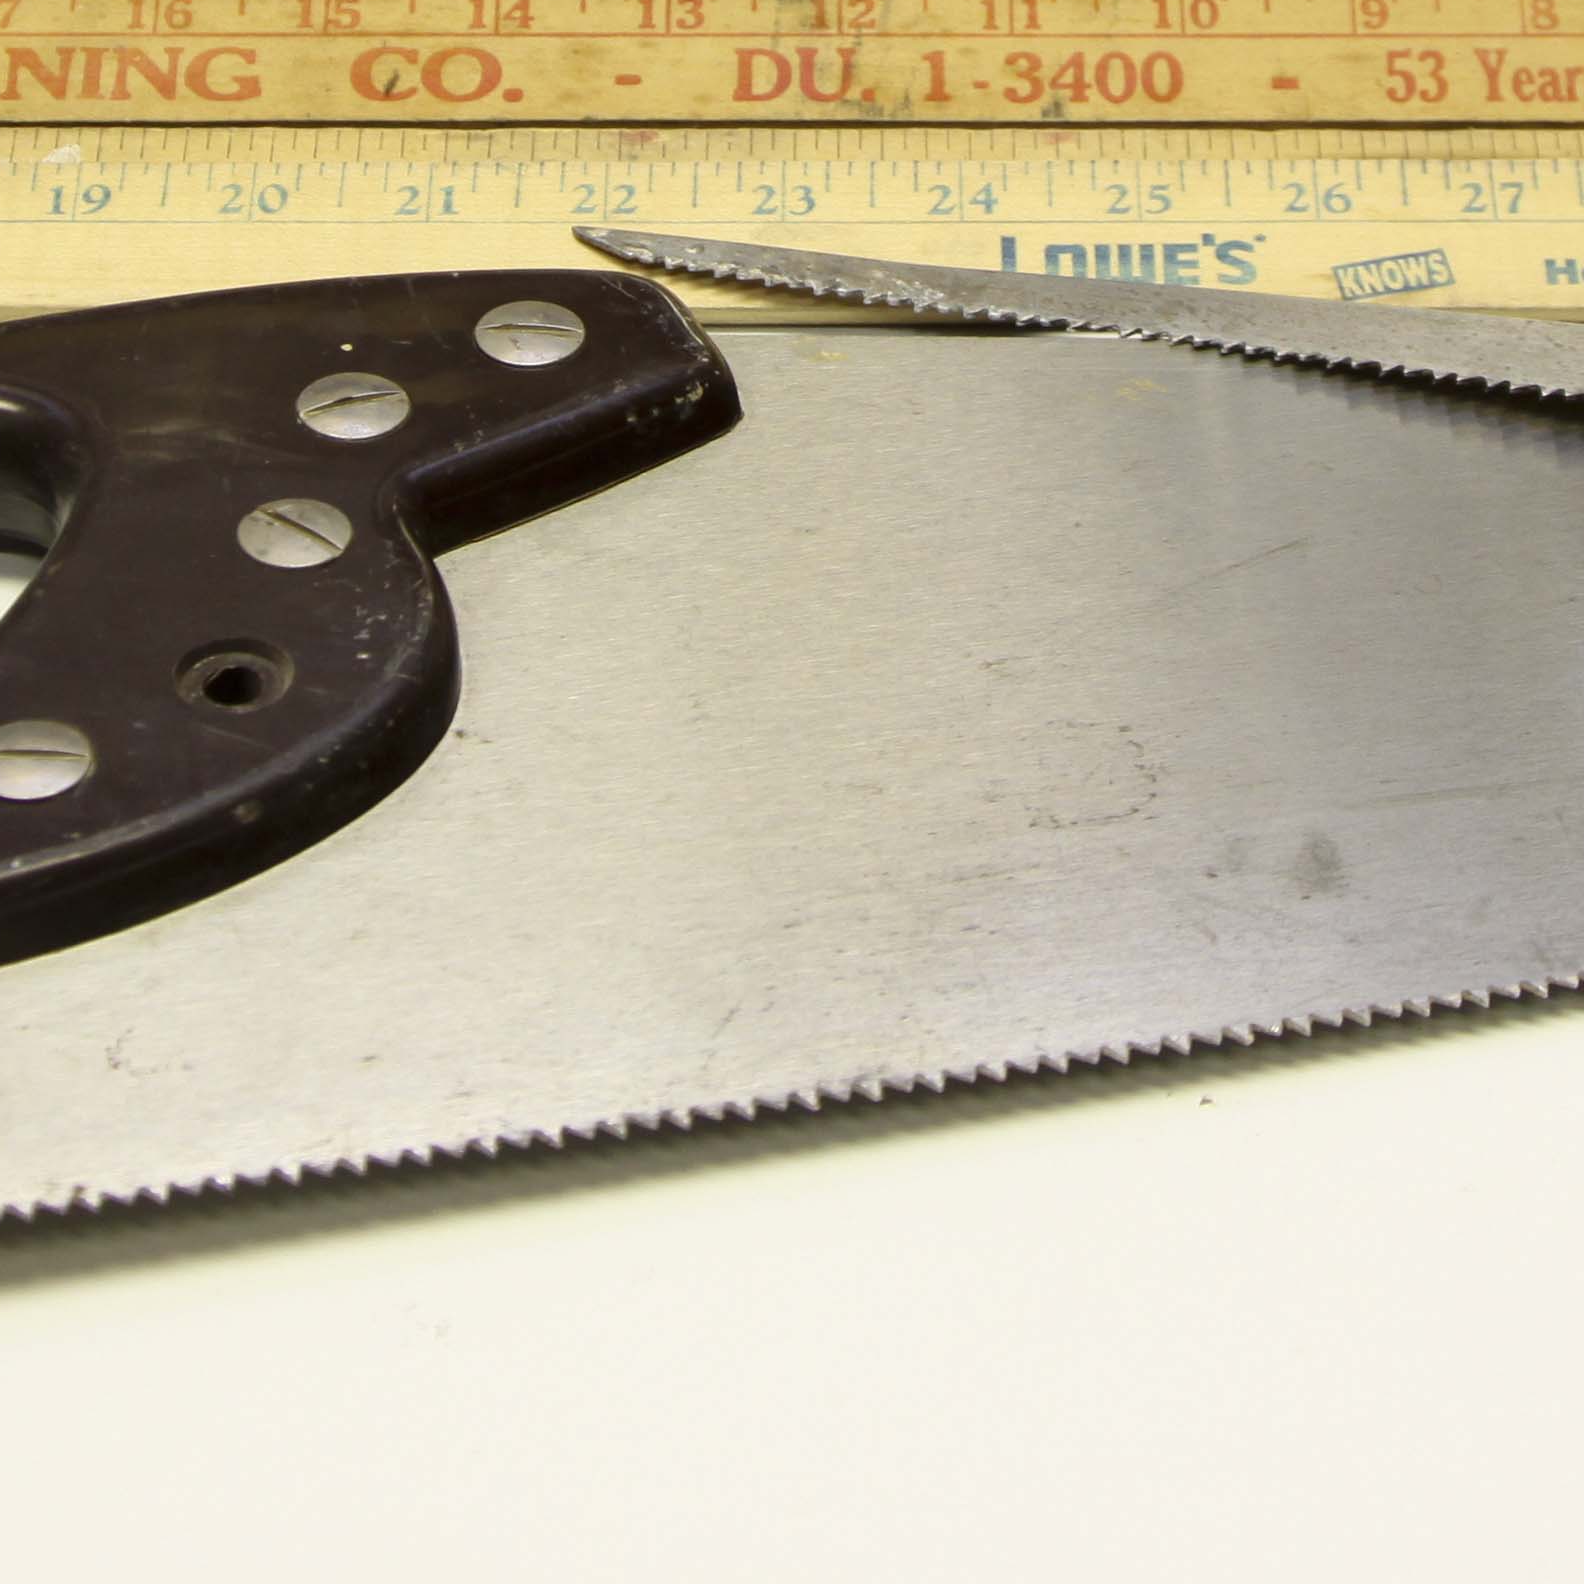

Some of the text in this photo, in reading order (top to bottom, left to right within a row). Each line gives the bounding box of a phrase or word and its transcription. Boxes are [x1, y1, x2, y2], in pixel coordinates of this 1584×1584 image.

[350, 47, 524, 102] CO.
[733, 48, 875, 102] DU.
[922, 50, 1184, 104] 1-3400
[1385, 49, 1448, 102] 53
[48, 184, 111, 214] 19
[220, 184, 287, 214] 20
[396, 185, 459, 214] 21
[572, 184, 637, 214] 22
[752, 184, 815, 214] 23
[927, 183, 998, 214] 24
[1106, 183, 1172, 214] 25
[1282, 182, 1352, 214] 26
[1461, 182, 1524, 214] 27
[1341, 254, 1446, 297] KNOWS
